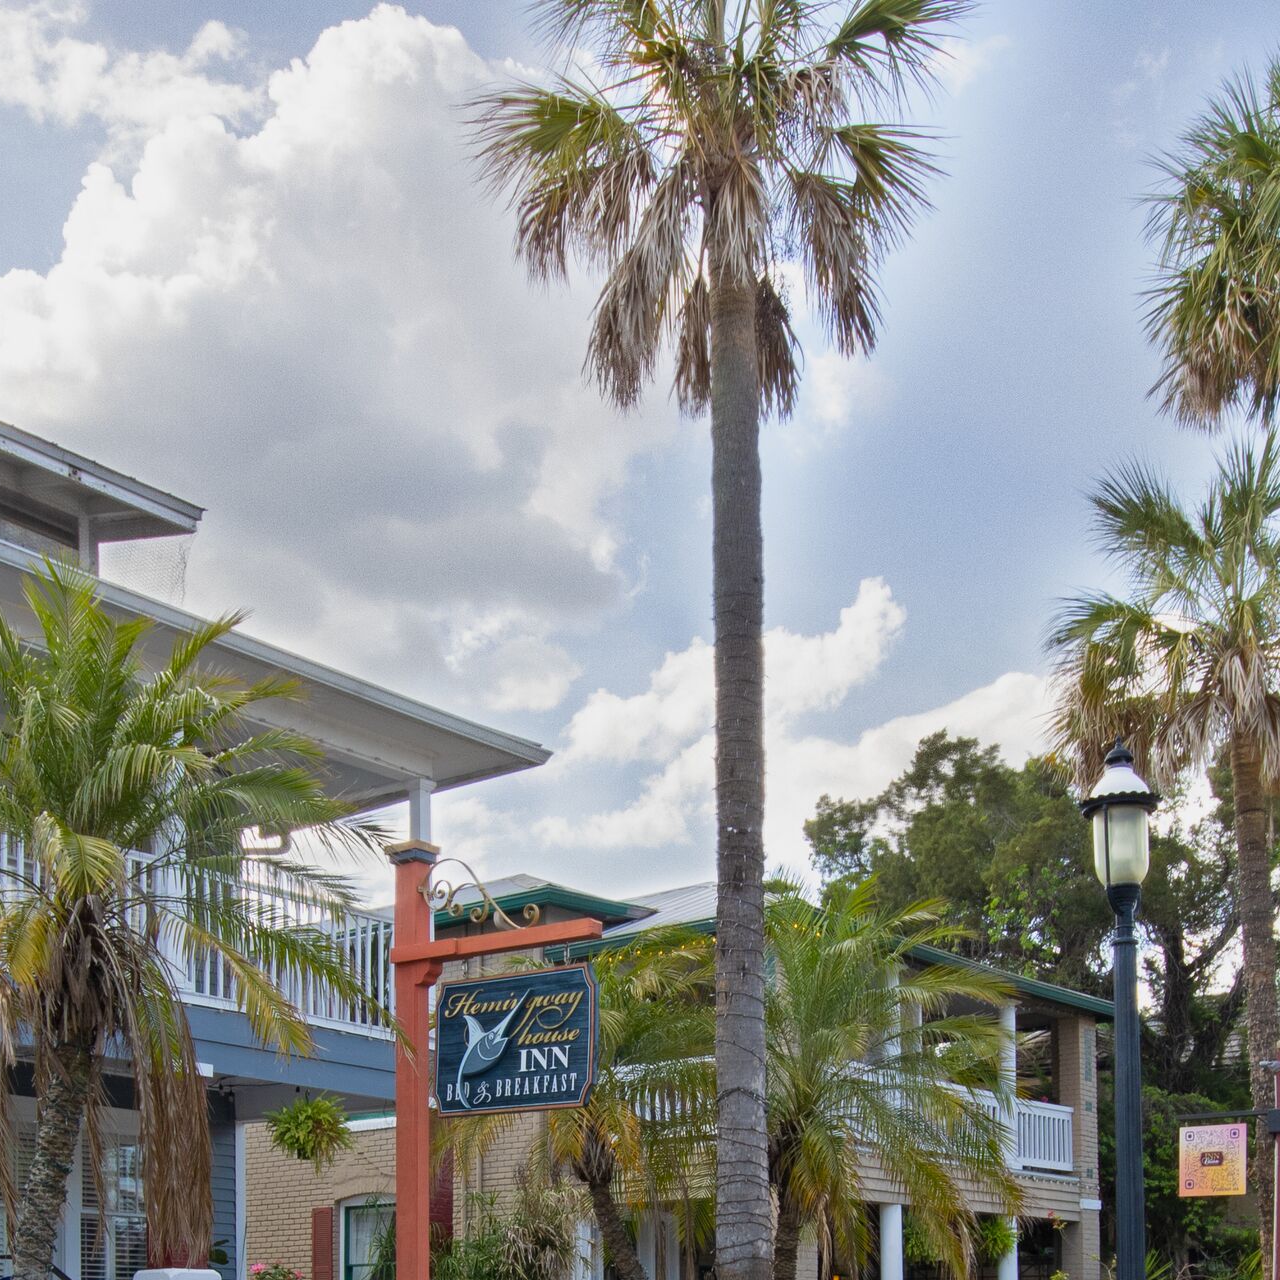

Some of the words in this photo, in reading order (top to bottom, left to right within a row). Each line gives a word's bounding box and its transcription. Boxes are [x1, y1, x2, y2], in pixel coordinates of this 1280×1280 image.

[517, 1019, 580, 1046] house
[517, 1045, 571, 1073] INN
[473, 1081, 492, 1105] &
[495, 1073, 578, 1098] BREAKFAST
